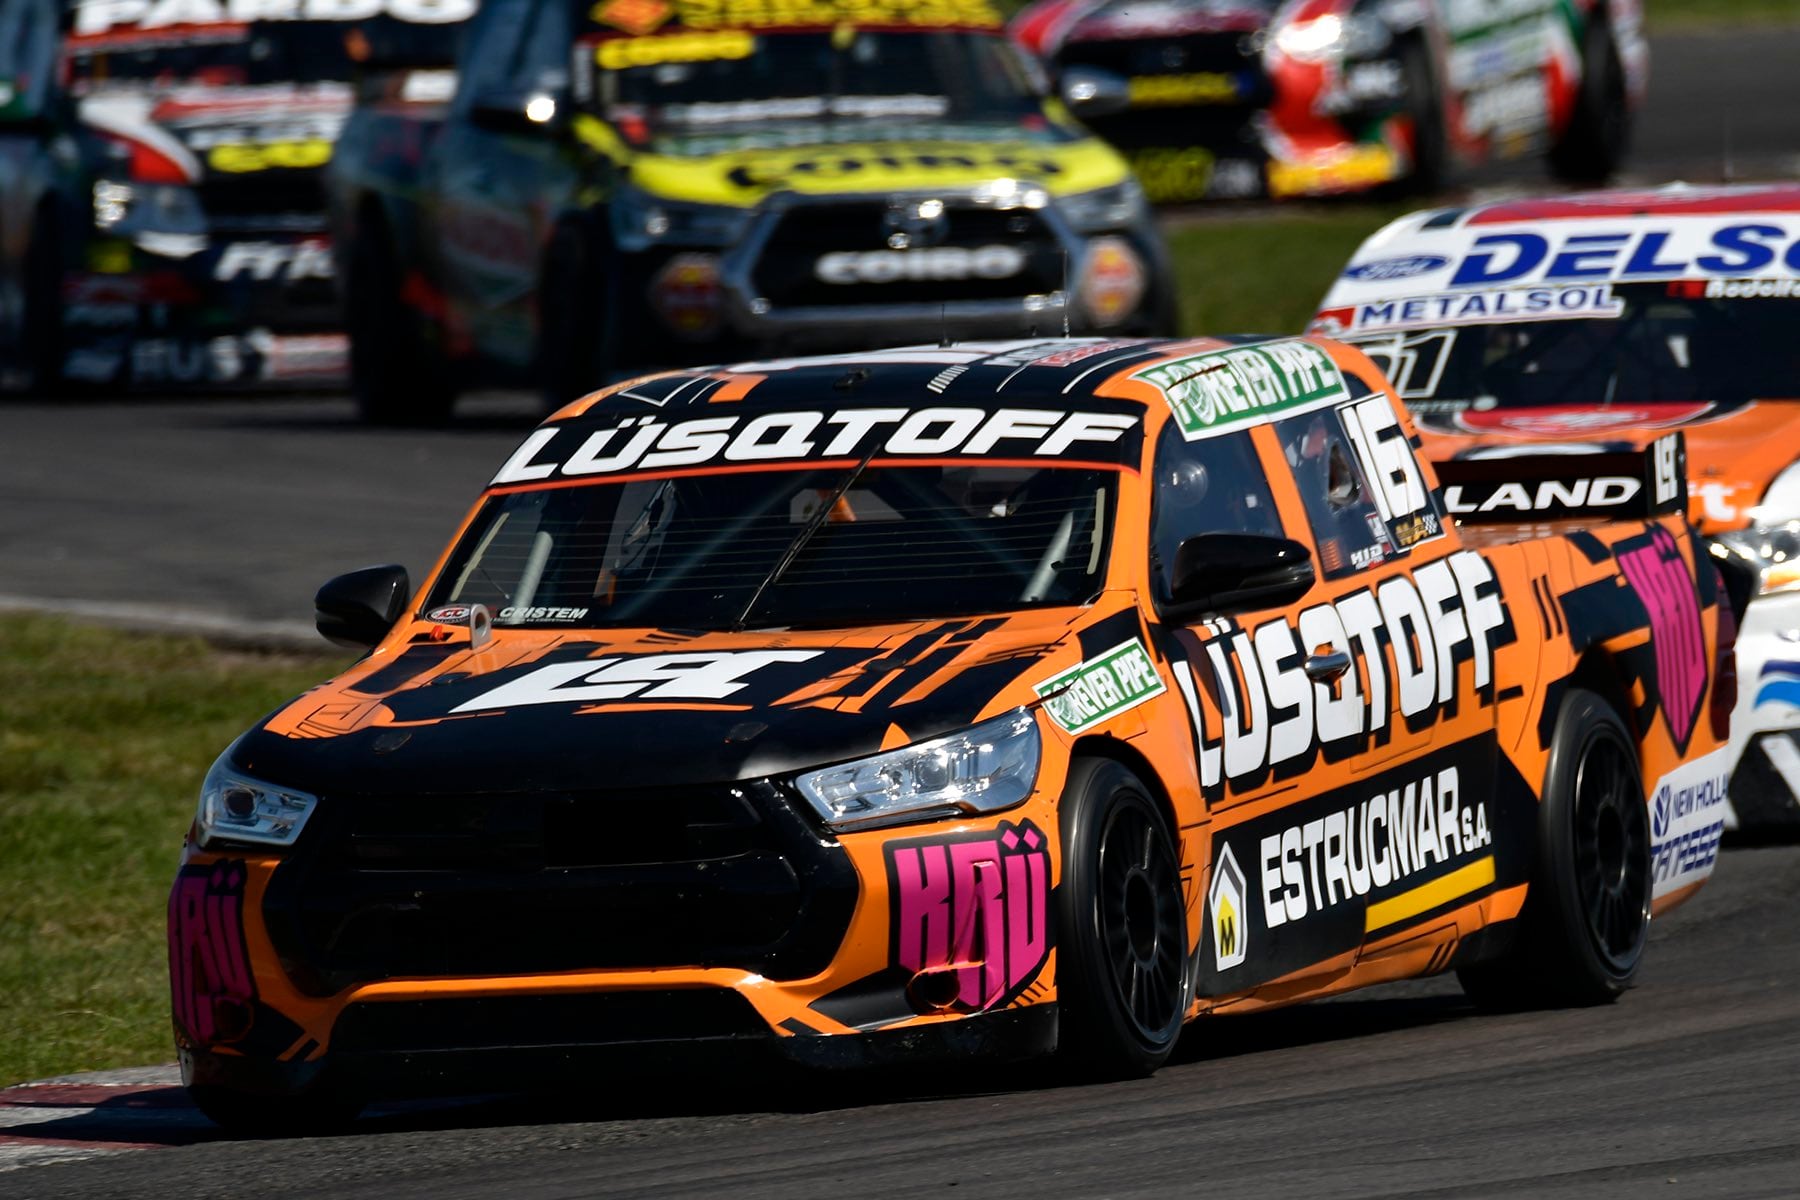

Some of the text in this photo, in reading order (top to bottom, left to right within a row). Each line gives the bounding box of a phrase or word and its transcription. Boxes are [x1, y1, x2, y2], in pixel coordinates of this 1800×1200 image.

[1359, 284, 1620, 325] METALSOL
[1146, 350, 1287, 425] FOREVER
[1257, 342, 1341, 398] PIPE
[491, 407, 1142, 486] LÜSQTOFF
[1342, 395, 1427, 521] 16
[500, 606, 588, 619] CRISTEM
[1042, 647, 1158, 728] FOREVER PIPE
[1172, 550, 1505, 788] LÜSQTOFF
[1671, 786, 1695, 820] NEW
[1260, 766, 1464, 928] ESTRUCMAR
[1220, 915, 1236, 958] M
